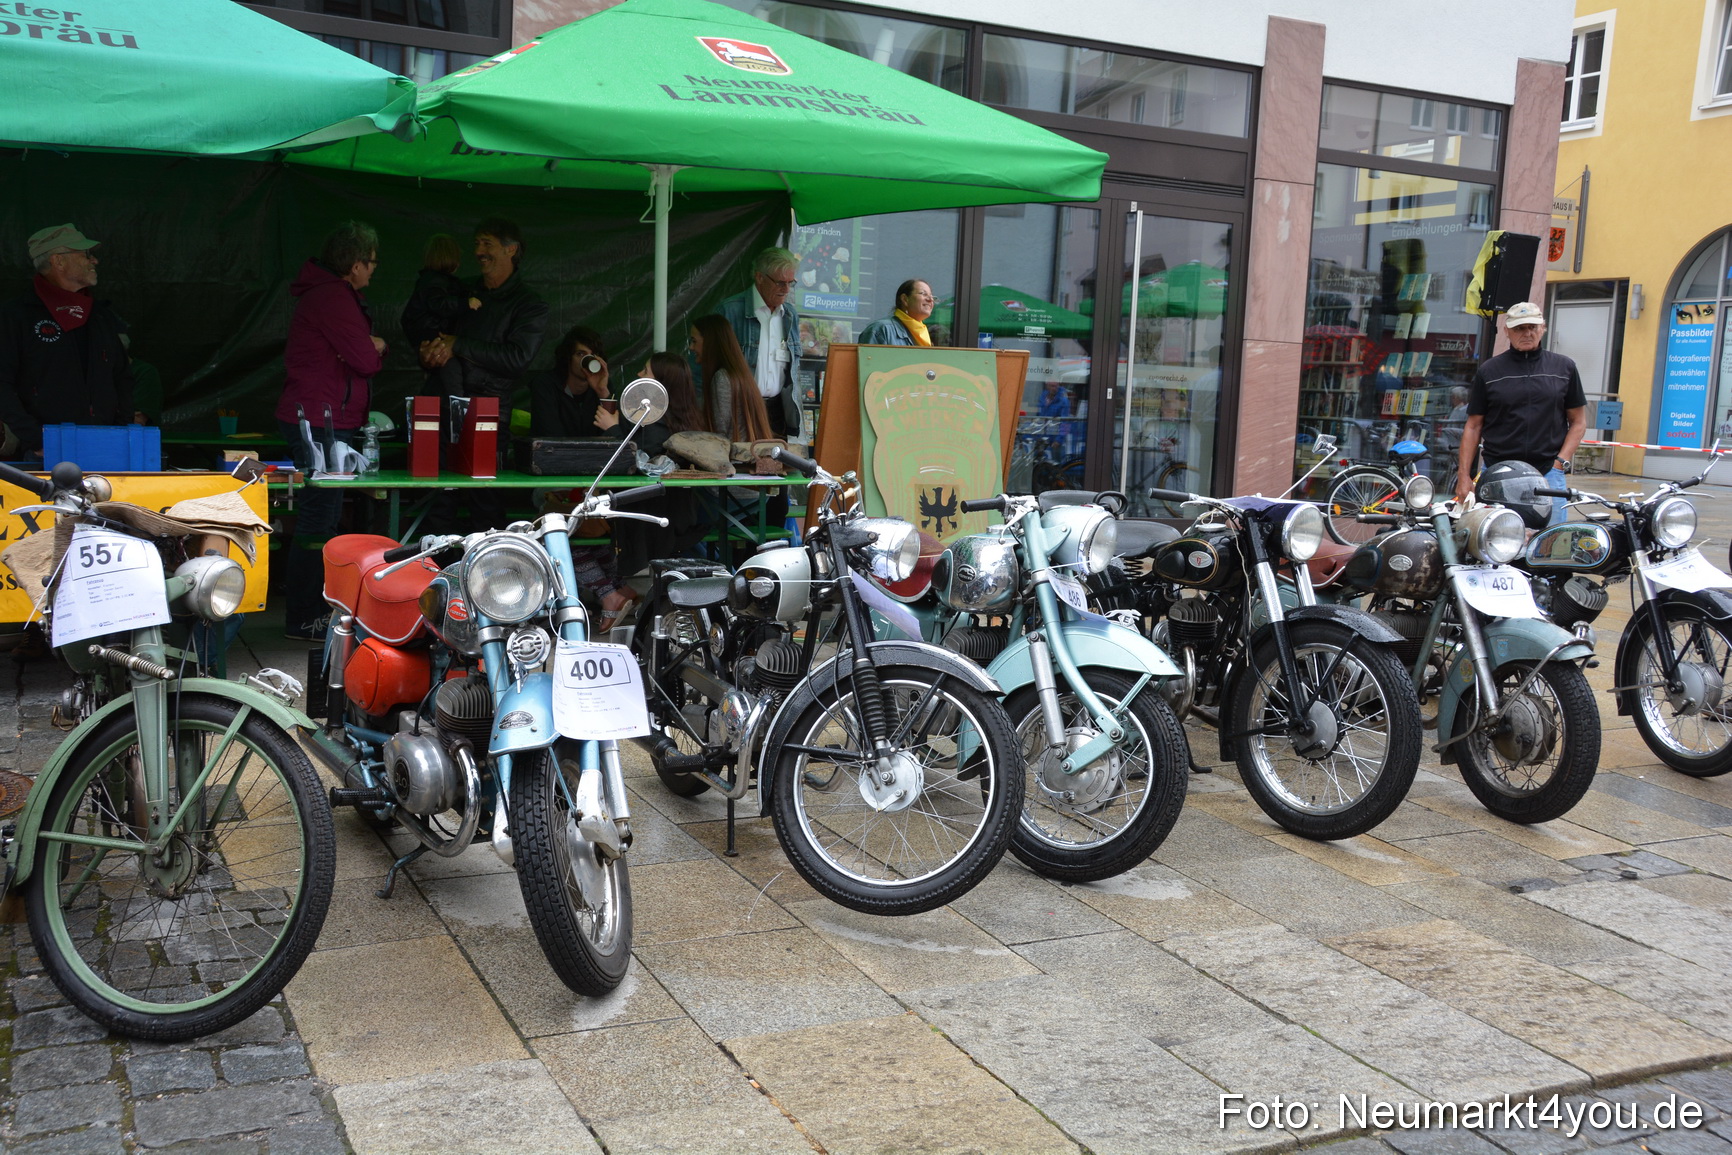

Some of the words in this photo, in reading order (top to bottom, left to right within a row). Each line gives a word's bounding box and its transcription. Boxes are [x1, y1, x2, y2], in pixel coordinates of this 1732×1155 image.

[684, 74, 872, 104] Neumarkter
[657, 84, 927, 127] Lammsbräu
[796, 225, 815, 234] Pilze
[817, 227, 841, 236] finden
[1392, 222, 1463, 239] Empfehlungen
[816, 296, 856, 309] Rupprecht
[1670, 328, 1713, 337] Passbilder
[1668, 354, 1710, 364] fotografieren
[1670, 369, 1706, 377] auswählen
[1668, 383, 1705, 391] mitnehmen
[1606, 415, 1612, 425] 2
[1670, 412, 1696, 420] Digitale
[1666, 431, 1696, 439] sofort
[80, 543, 127, 568] 557
[1492, 577, 1514, 591] 487
[1068, 589, 1081, 608] 486
[1123, 615, 1131, 624] E
[570, 657, 613, 681] 400
